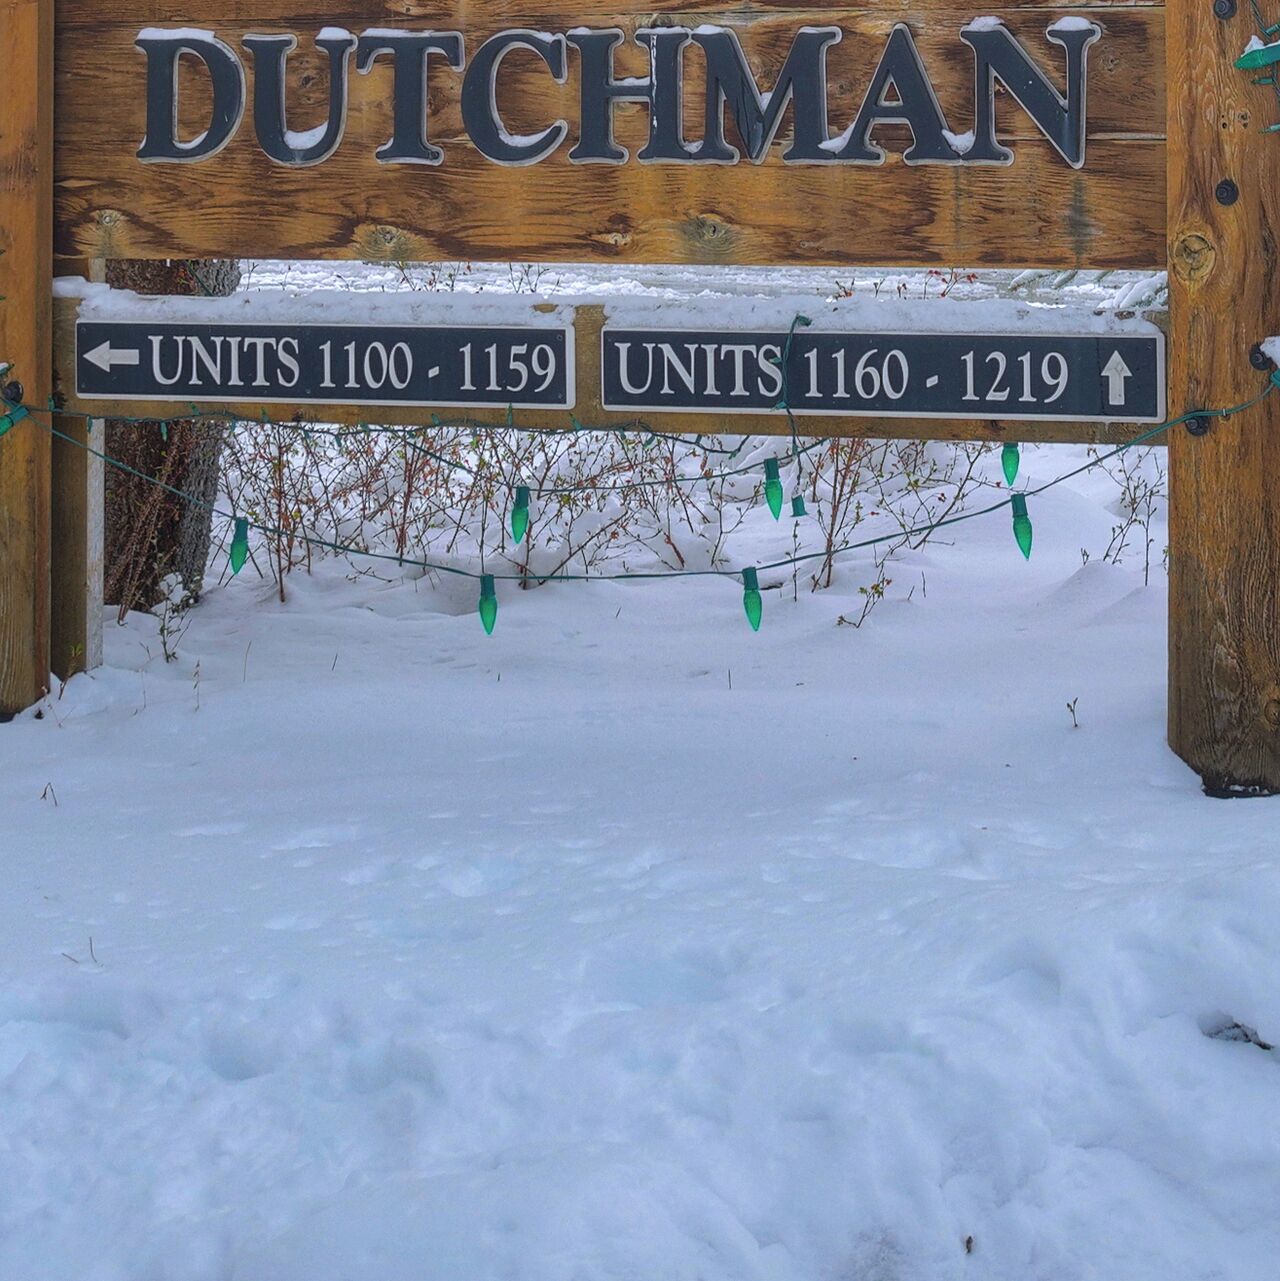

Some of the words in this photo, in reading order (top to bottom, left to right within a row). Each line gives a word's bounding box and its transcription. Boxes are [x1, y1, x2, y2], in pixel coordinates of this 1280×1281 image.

[134, 17, 1103, 169] DUTCHMAN
[148, 335, 299, 388] UNITS
[319, 340, 413, 390] 1100
[459, 344, 557, 394] 1159
[614, 342, 783, 398] UNITS
[803, 349, 909, 400] 1160
[960, 351, 1070, 404] 1219
